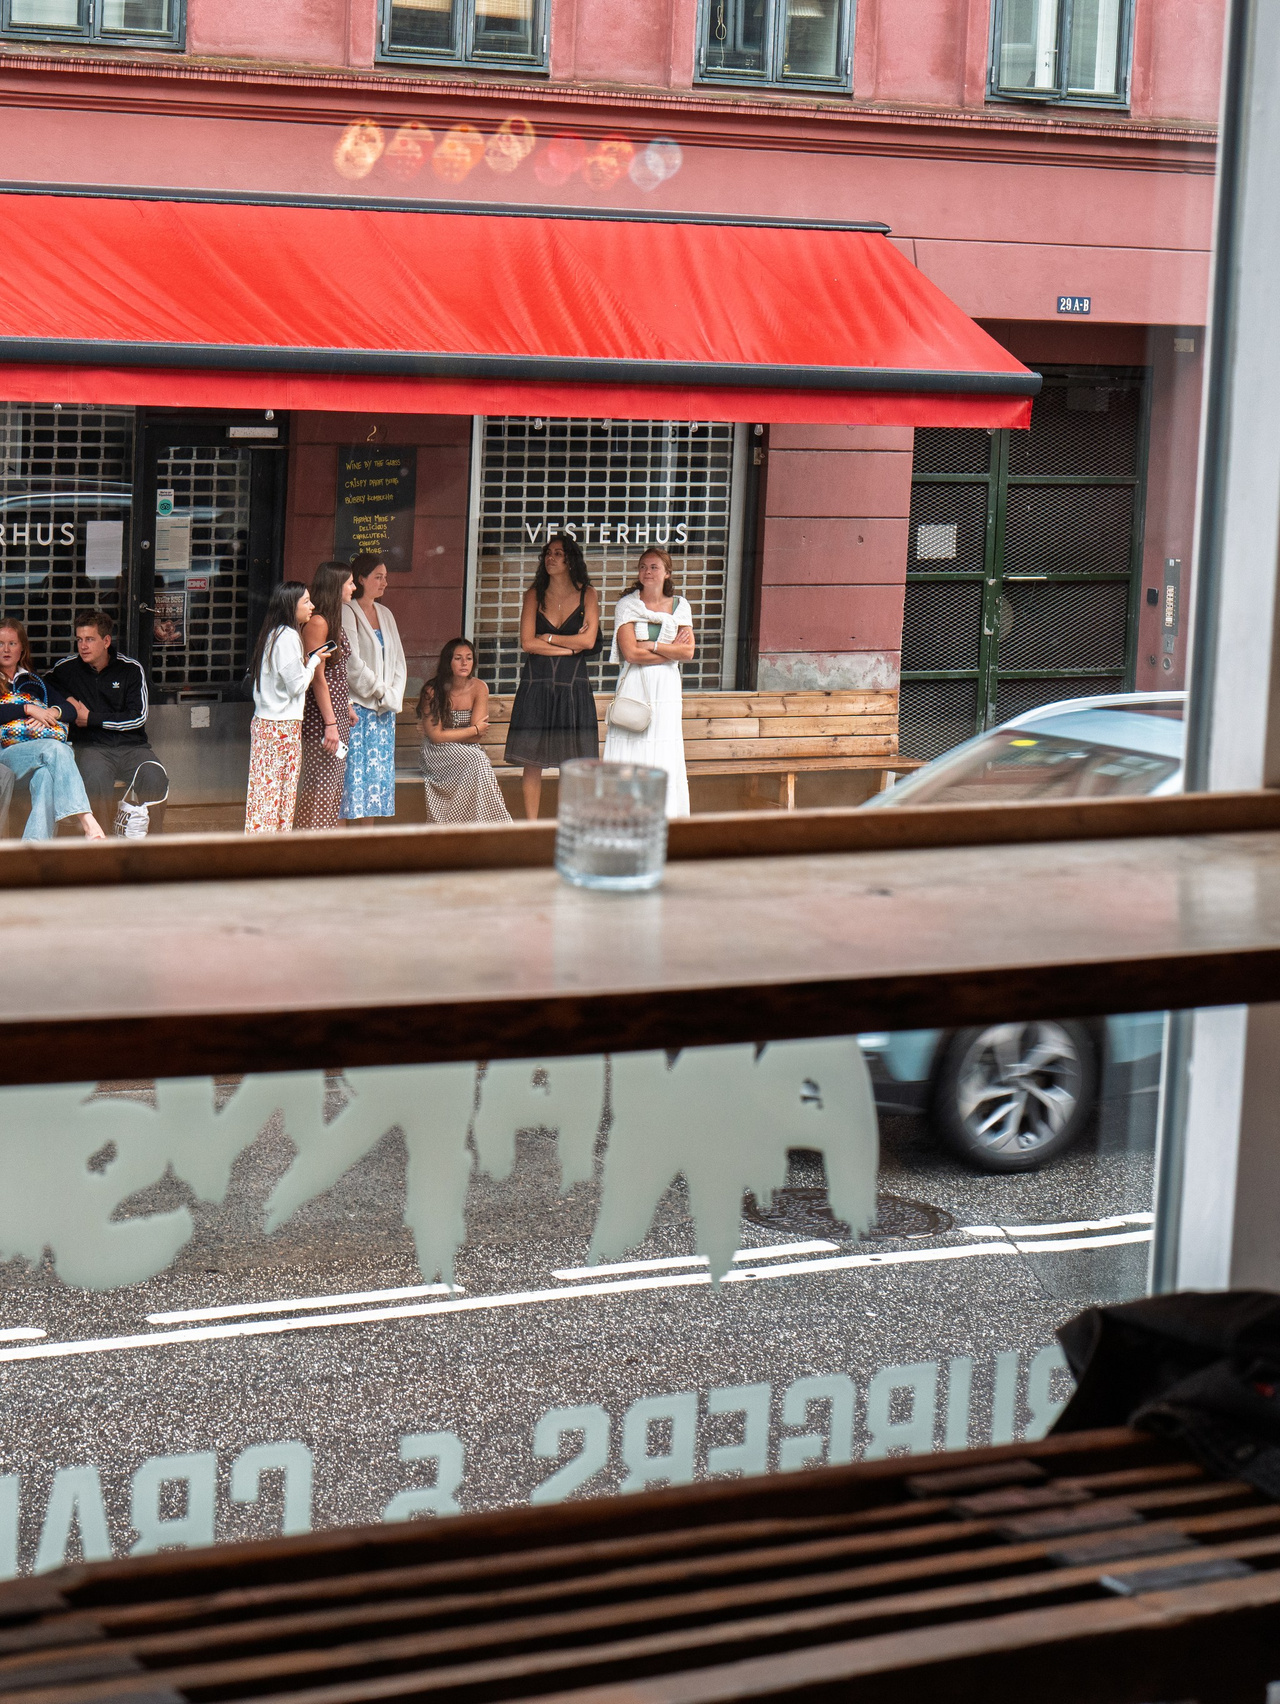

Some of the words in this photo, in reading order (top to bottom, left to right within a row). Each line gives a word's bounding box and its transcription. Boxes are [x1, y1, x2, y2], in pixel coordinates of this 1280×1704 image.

[1059, 297, 1072, 311] 29
[1073, 298, 1090, 312] A-B
[525, 522, 688, 544] VESTERHUS
